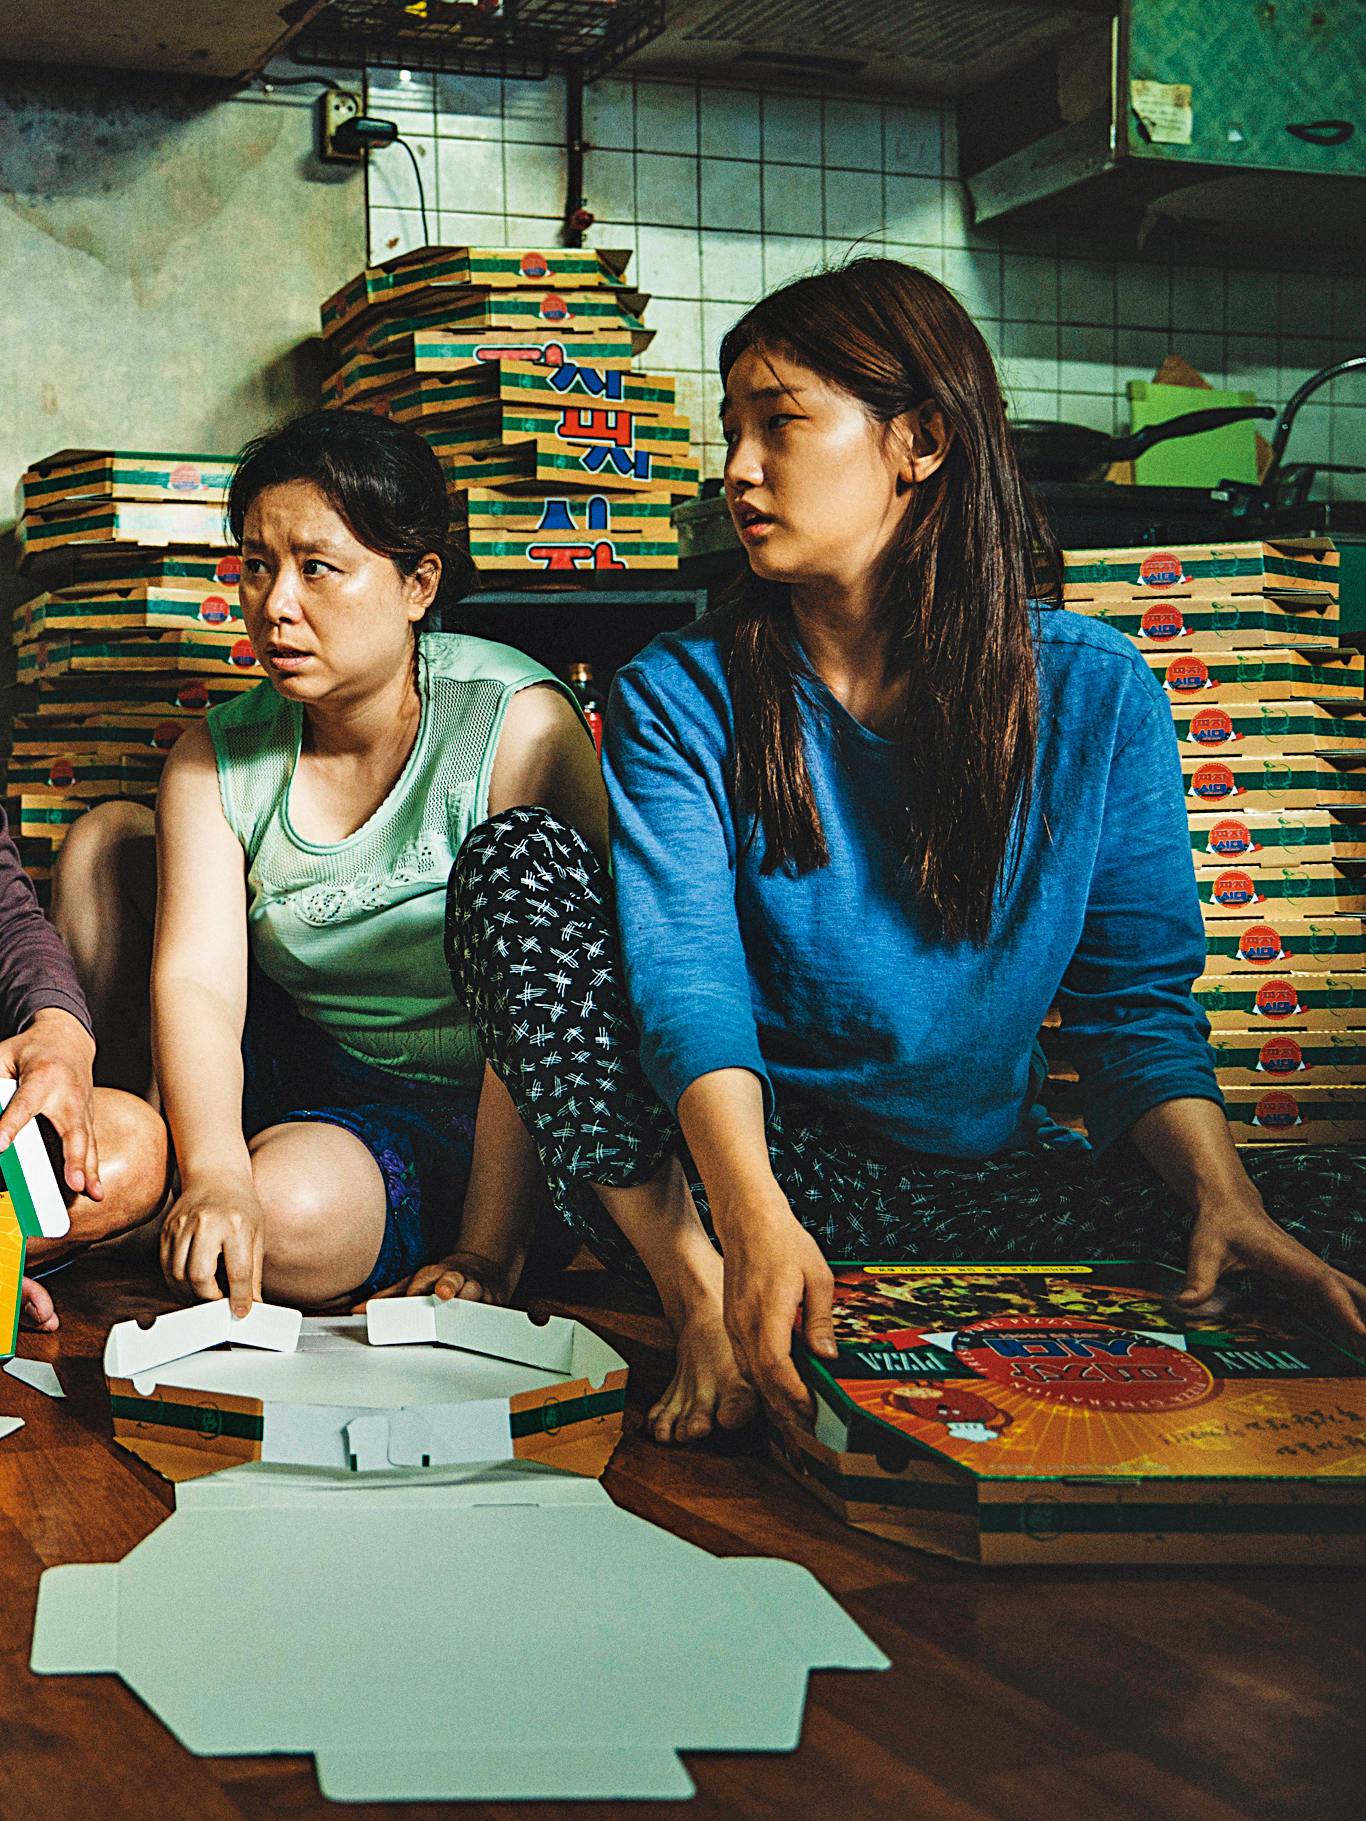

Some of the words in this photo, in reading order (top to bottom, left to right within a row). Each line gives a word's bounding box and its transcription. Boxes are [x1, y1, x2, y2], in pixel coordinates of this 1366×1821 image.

[1245, 934, 1277, 944] 피자
[1247, 945, 1275, 954] 시대
[1261, 989, 1293, 999] 피자
[1263, 1000, 1291, 1009] 시대
[982, 1337, 1137, 1359] 시대
[856, 1352, 947, 1372] PIZZA
[1212, 1350, 1312, 1370] ITALY
[1010, 1362, 1188, 1384] 피자
